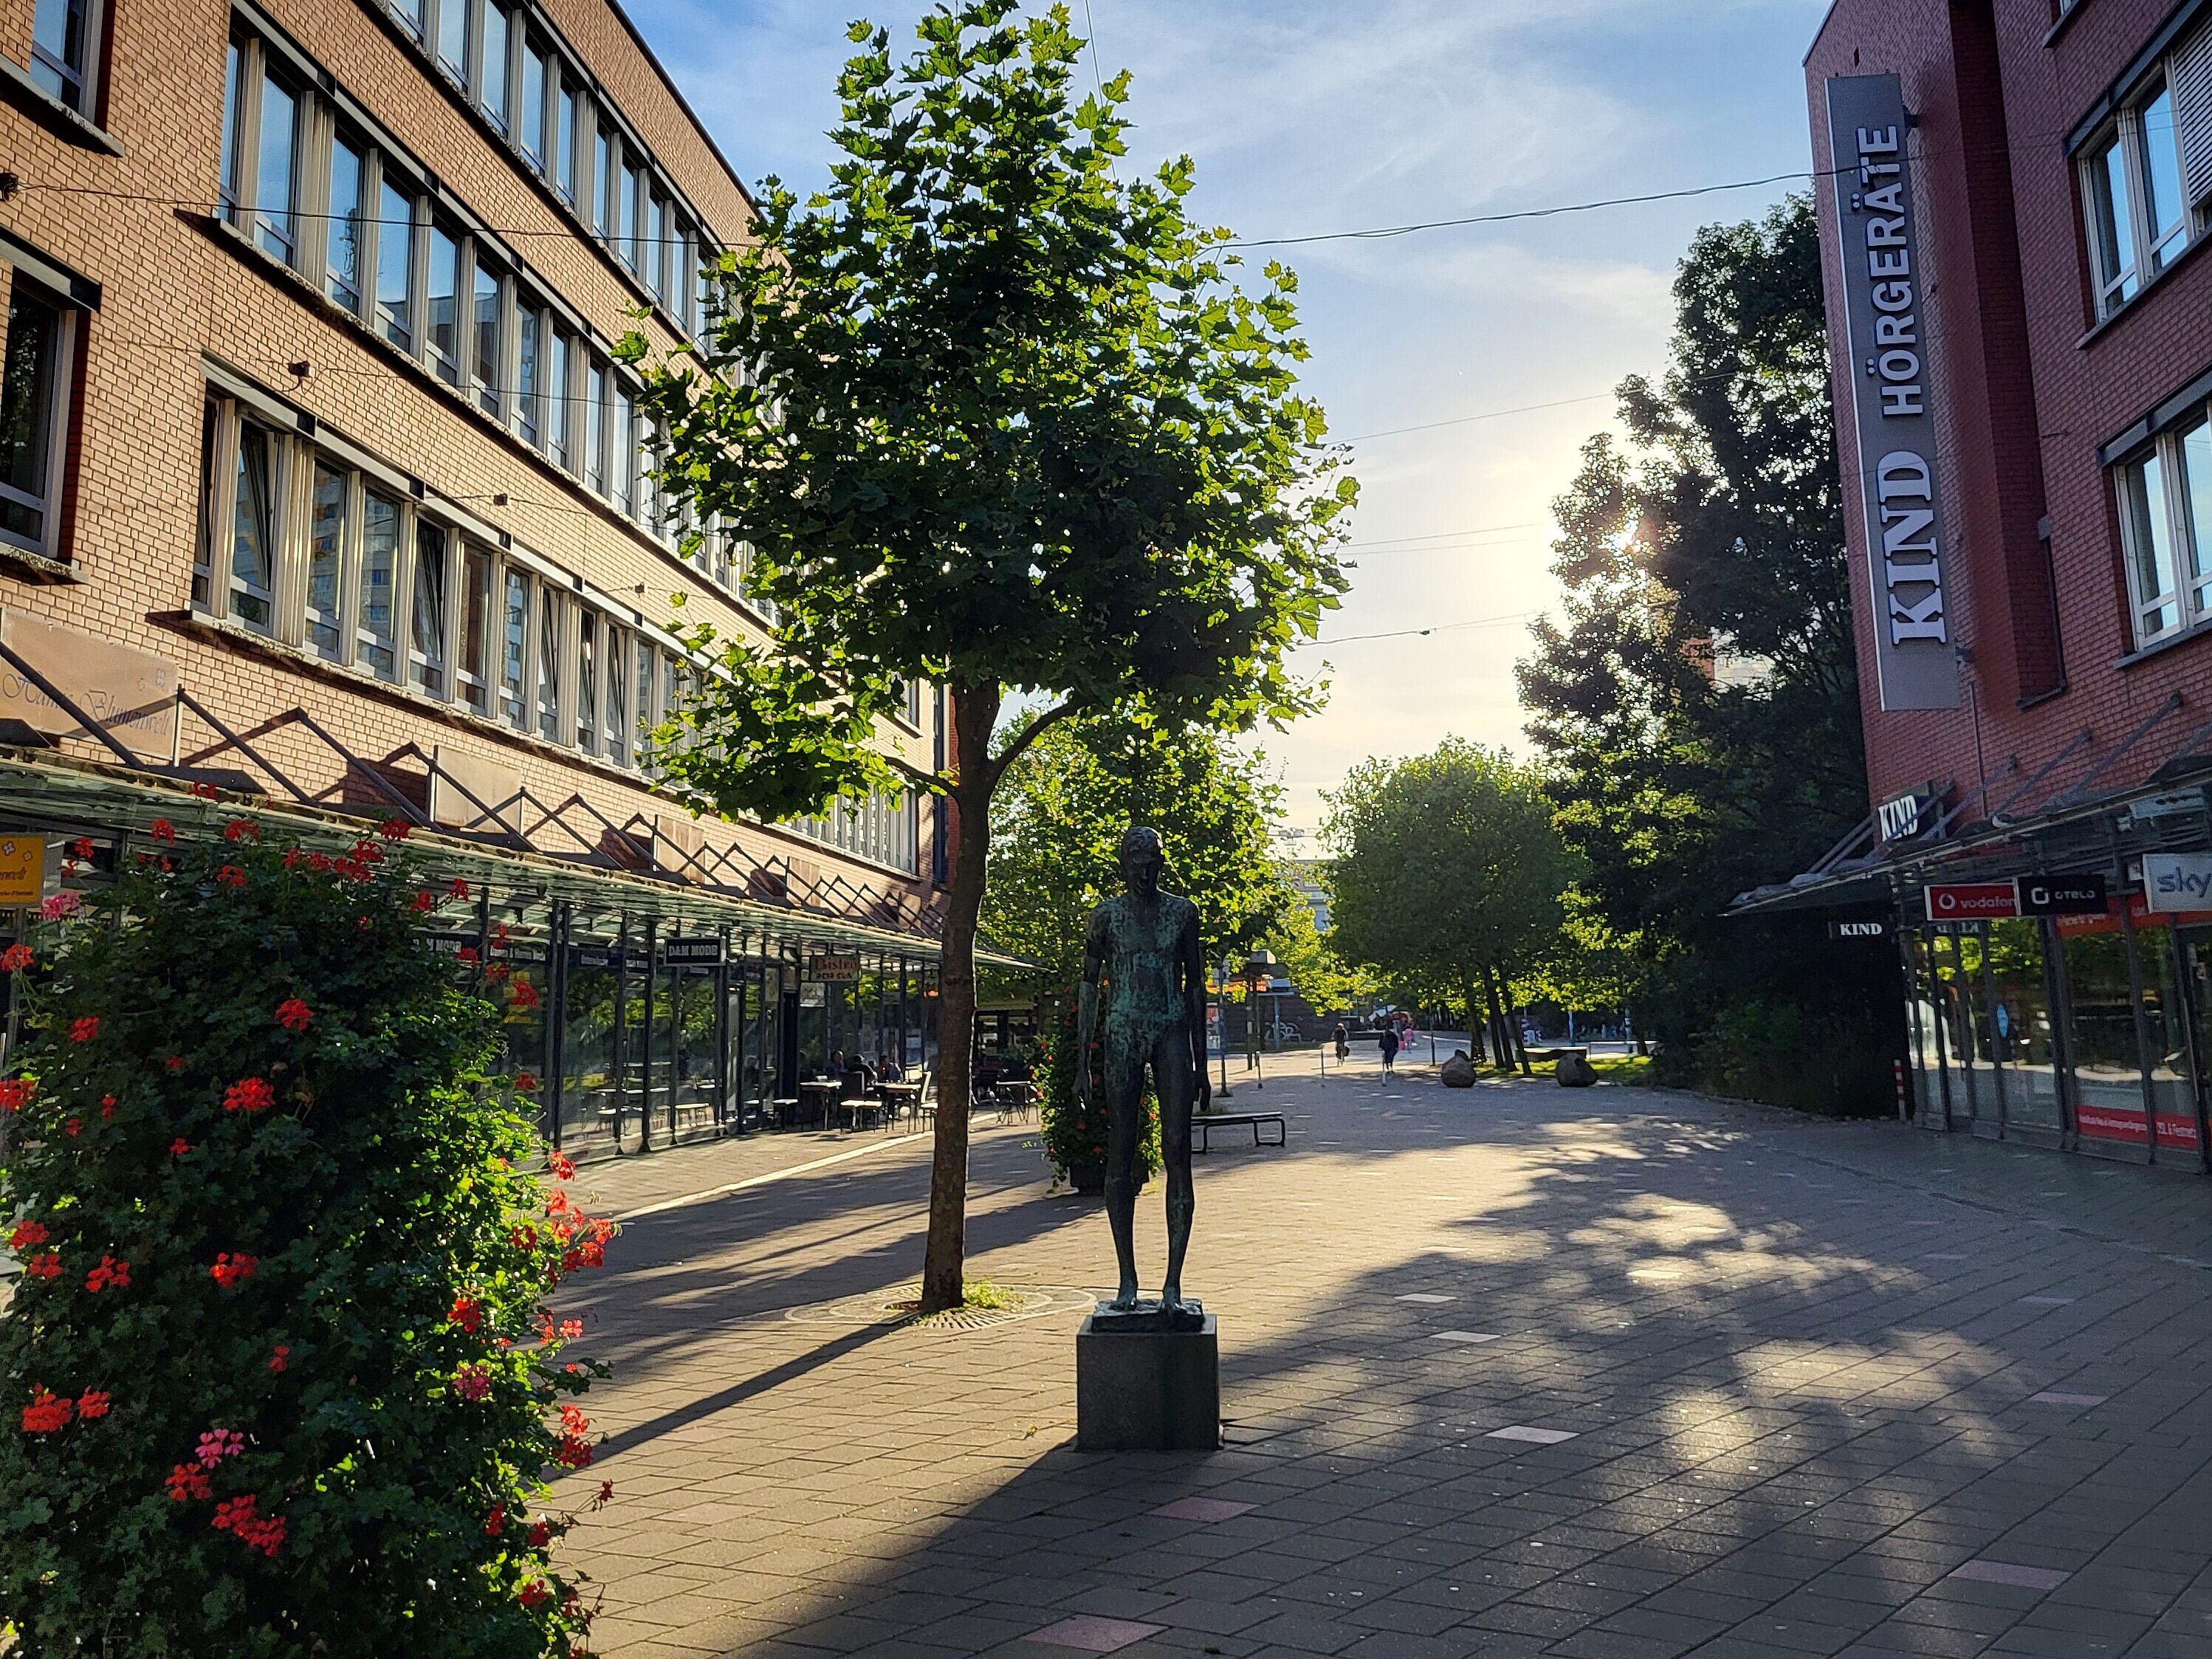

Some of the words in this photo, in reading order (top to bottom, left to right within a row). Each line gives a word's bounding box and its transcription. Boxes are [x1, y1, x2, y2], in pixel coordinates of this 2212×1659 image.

[1852, 126, 1923, 415] HÖRGERÄTE
[1878, 450, 1945, 645] KIND
[1878, 794, 1918, 842] KIND
[2157, 866, 2211, 899] sky
[1839, 923, 1883, 935] KIND
[691, 944, 718, 956] MODE
